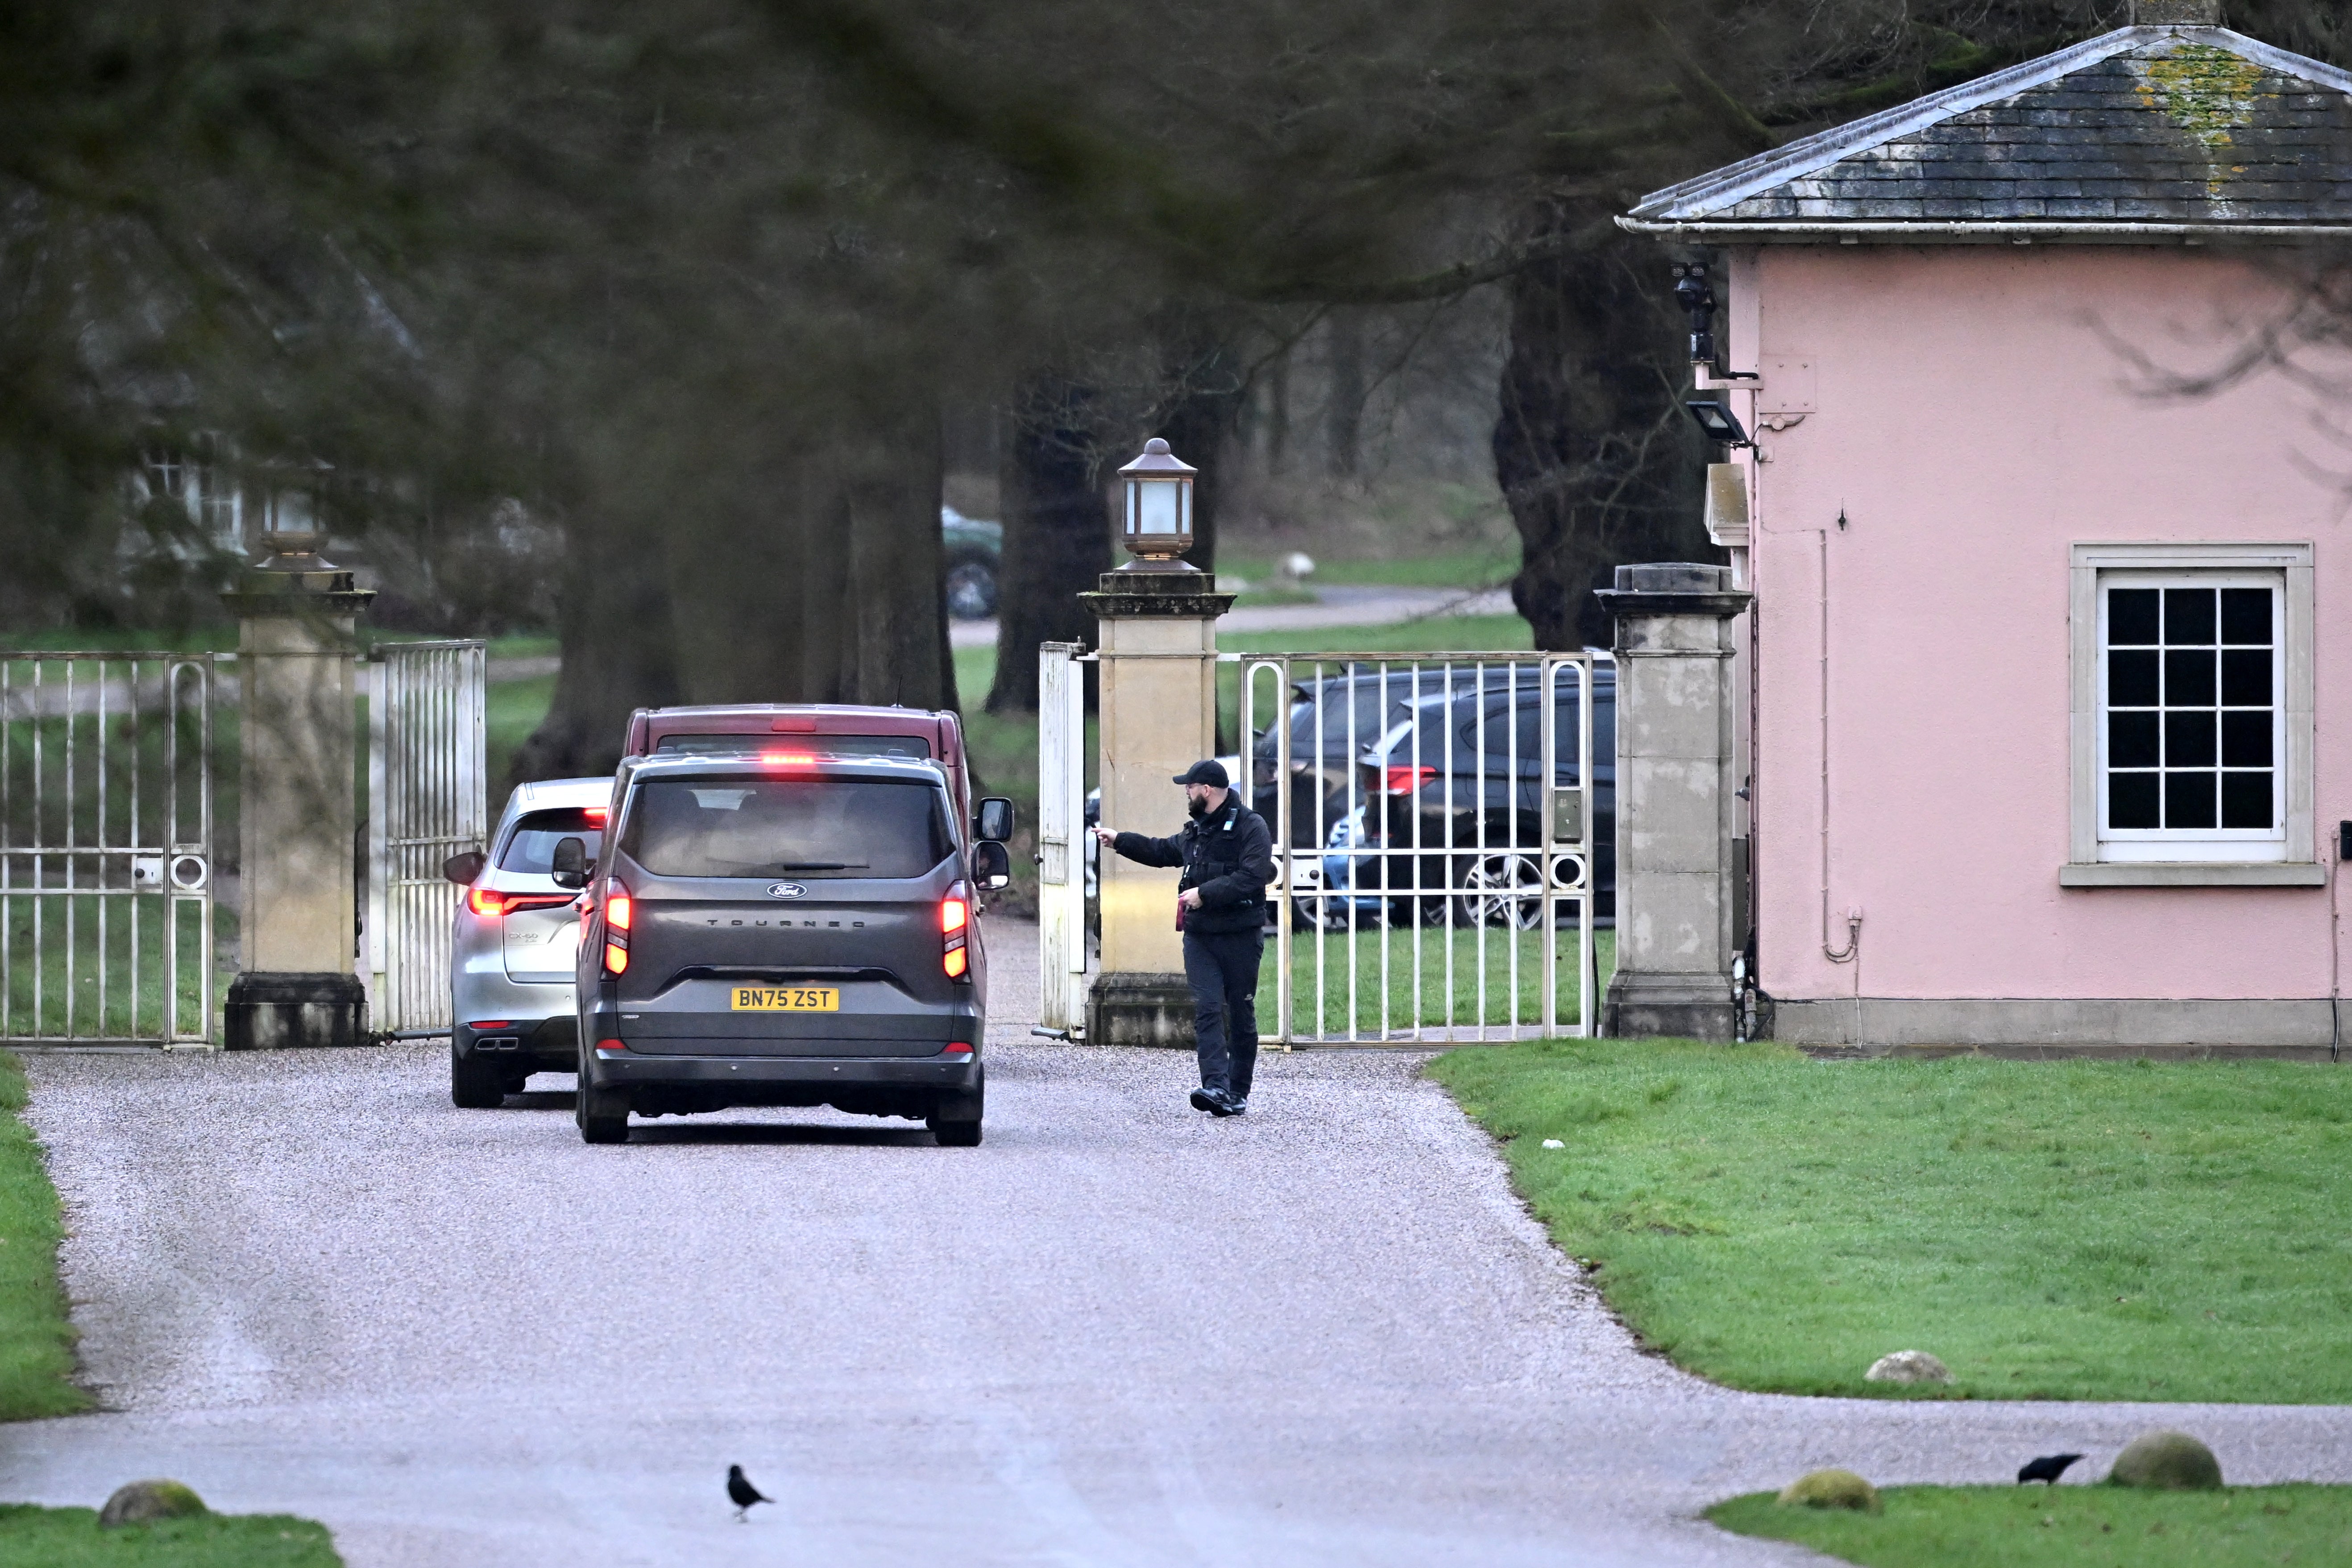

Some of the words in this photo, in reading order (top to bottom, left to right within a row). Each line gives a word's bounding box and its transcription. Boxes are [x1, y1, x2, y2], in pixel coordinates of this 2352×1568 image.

[774, 885, 799, 896] Ford
[707, 919, 864, 928] TOURNEO
[739, 990, 788, 1007] BN75
[794, 991, 830, 1007] ZST
